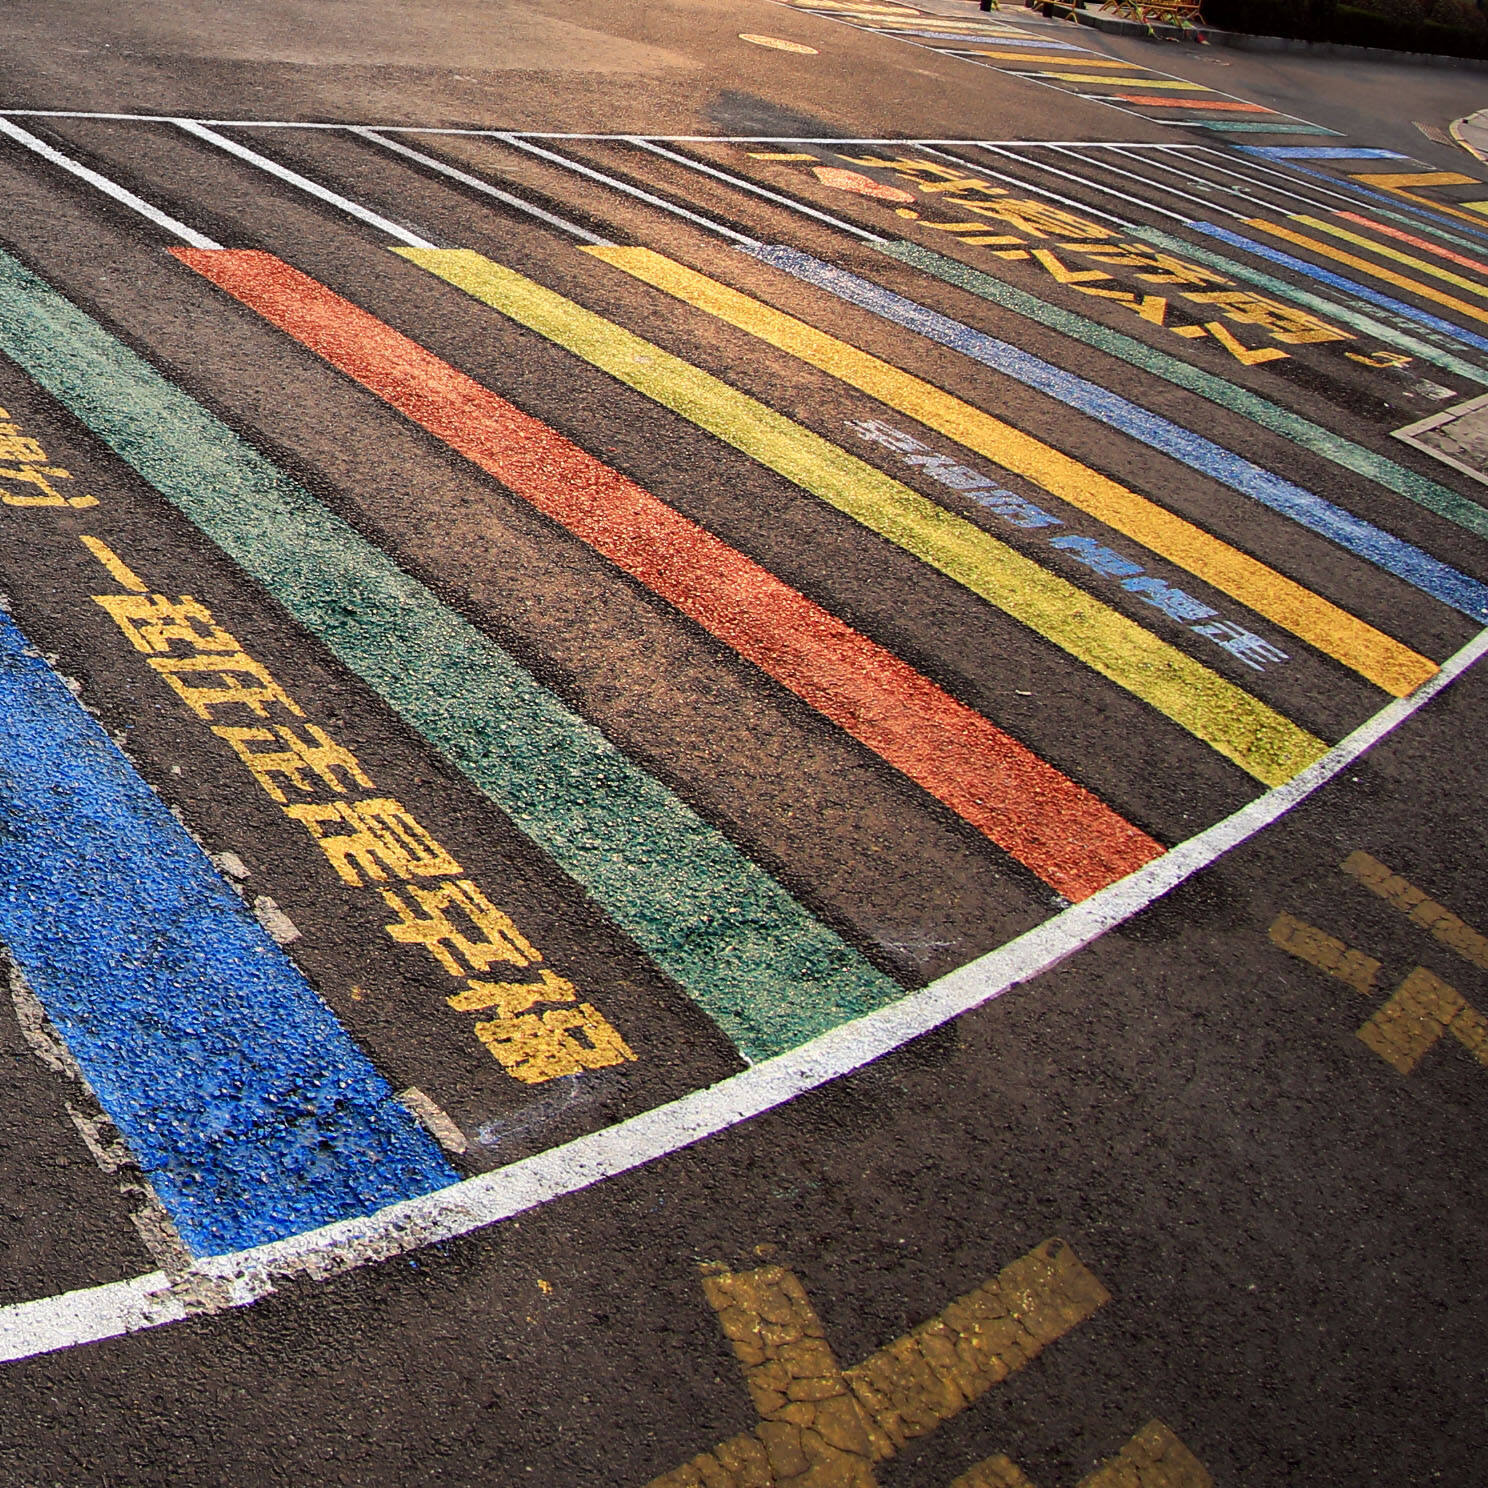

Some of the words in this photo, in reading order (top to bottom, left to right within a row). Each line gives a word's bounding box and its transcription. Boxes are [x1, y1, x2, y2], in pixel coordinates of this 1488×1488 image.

[835, 152, 1359, 346] 我爱济南
[894, 207, 1293, 368] JINAN
